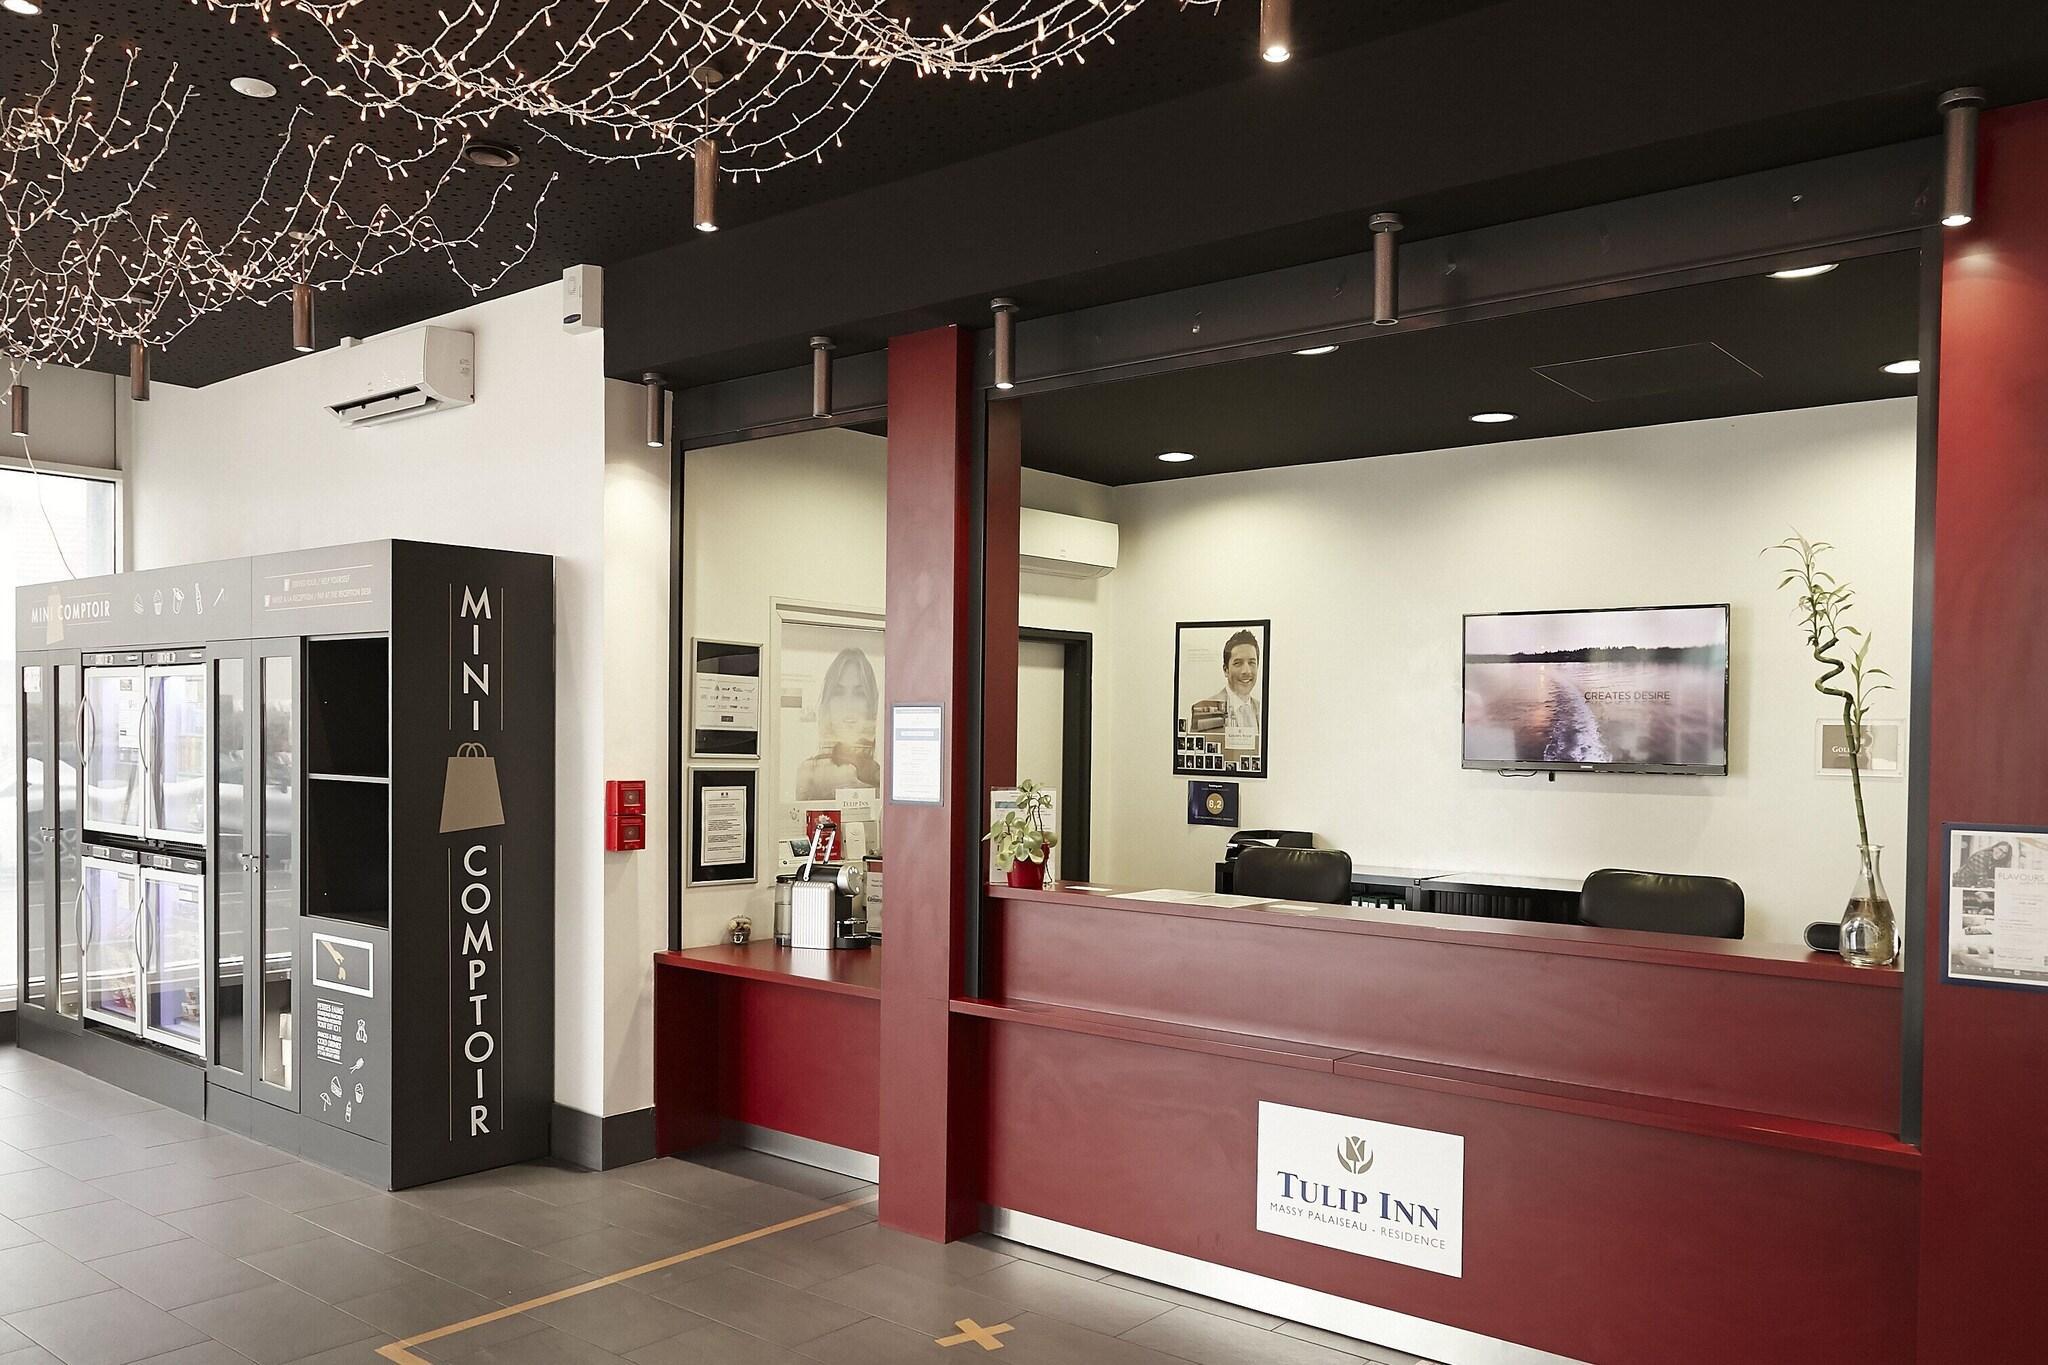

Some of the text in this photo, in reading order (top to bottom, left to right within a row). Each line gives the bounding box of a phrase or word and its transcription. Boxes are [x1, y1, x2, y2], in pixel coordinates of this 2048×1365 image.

[31, 600, 110, 623] MINI COMPTOIR
[460, 585, 492, 731] MINI
[1584, 690, 1670, 700] CREATES DESIRE
[1208, 799, 1222, 809] 8,2
[461, 845, 495, 1136] COMPTOIR
[1277, 1171, 1440, 1231] TULIP INN
[1270, 1202, 1303, 1217] MASSY
[1308, 1210, 1367, 1232] PALAISEAU
[1381, 1227, 1446, 1250] RESIDENCE
